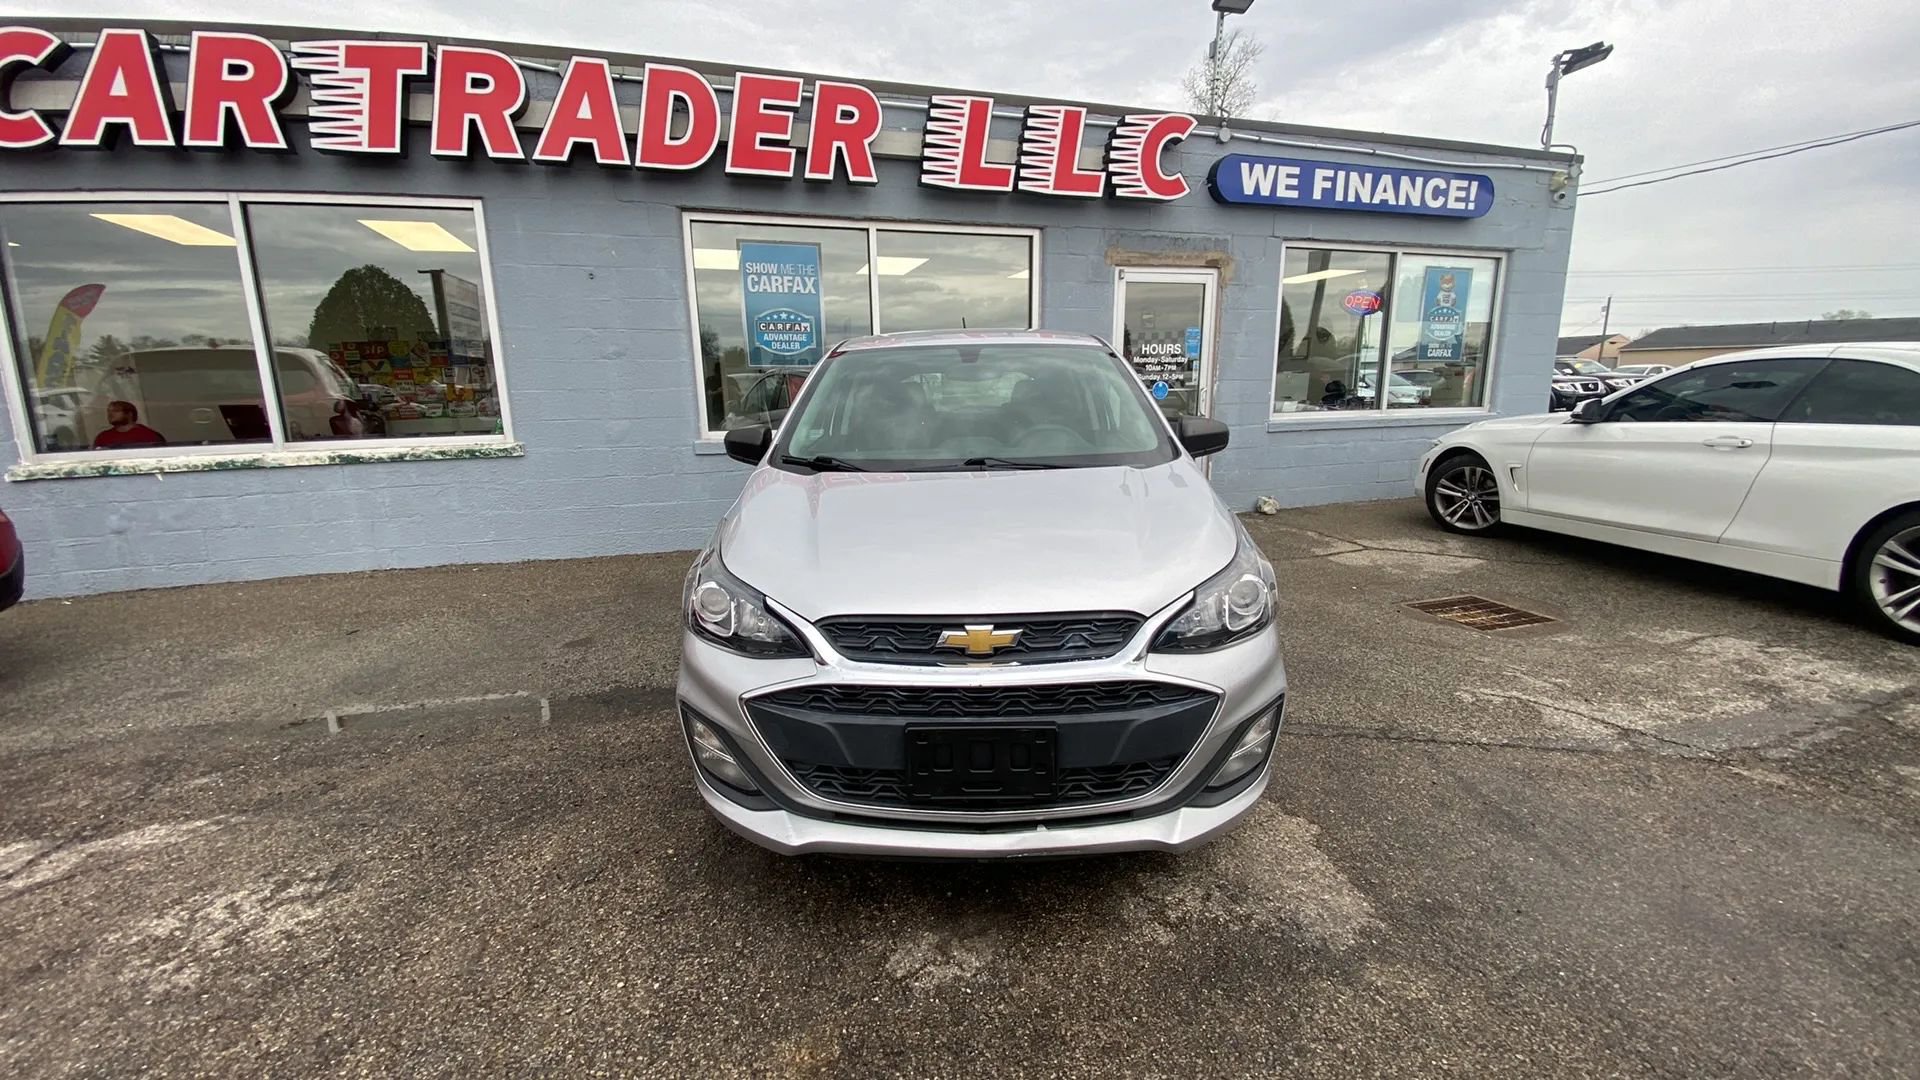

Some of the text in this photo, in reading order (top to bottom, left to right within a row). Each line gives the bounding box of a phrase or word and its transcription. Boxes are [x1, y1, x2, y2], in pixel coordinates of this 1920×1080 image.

[0, 26, 1199, 200] CAR TRADER LLC
[1240, 162, 1478, 210] WE FINANCE!
[745, 262, 815, 276] SHOW ME THE
[747, 274, 817, 294] CARFAX
[1344, 295, 1380, 309] OPEN
[760, 323, 810, 332] CARFAX
[763, 333, 807, 341] ADVANTAGE
[772, 342, 800, 350] DEALER
[1141, 343, 1182, 355] HOURS
[1427, 348, 1453, 357] CARFAX
